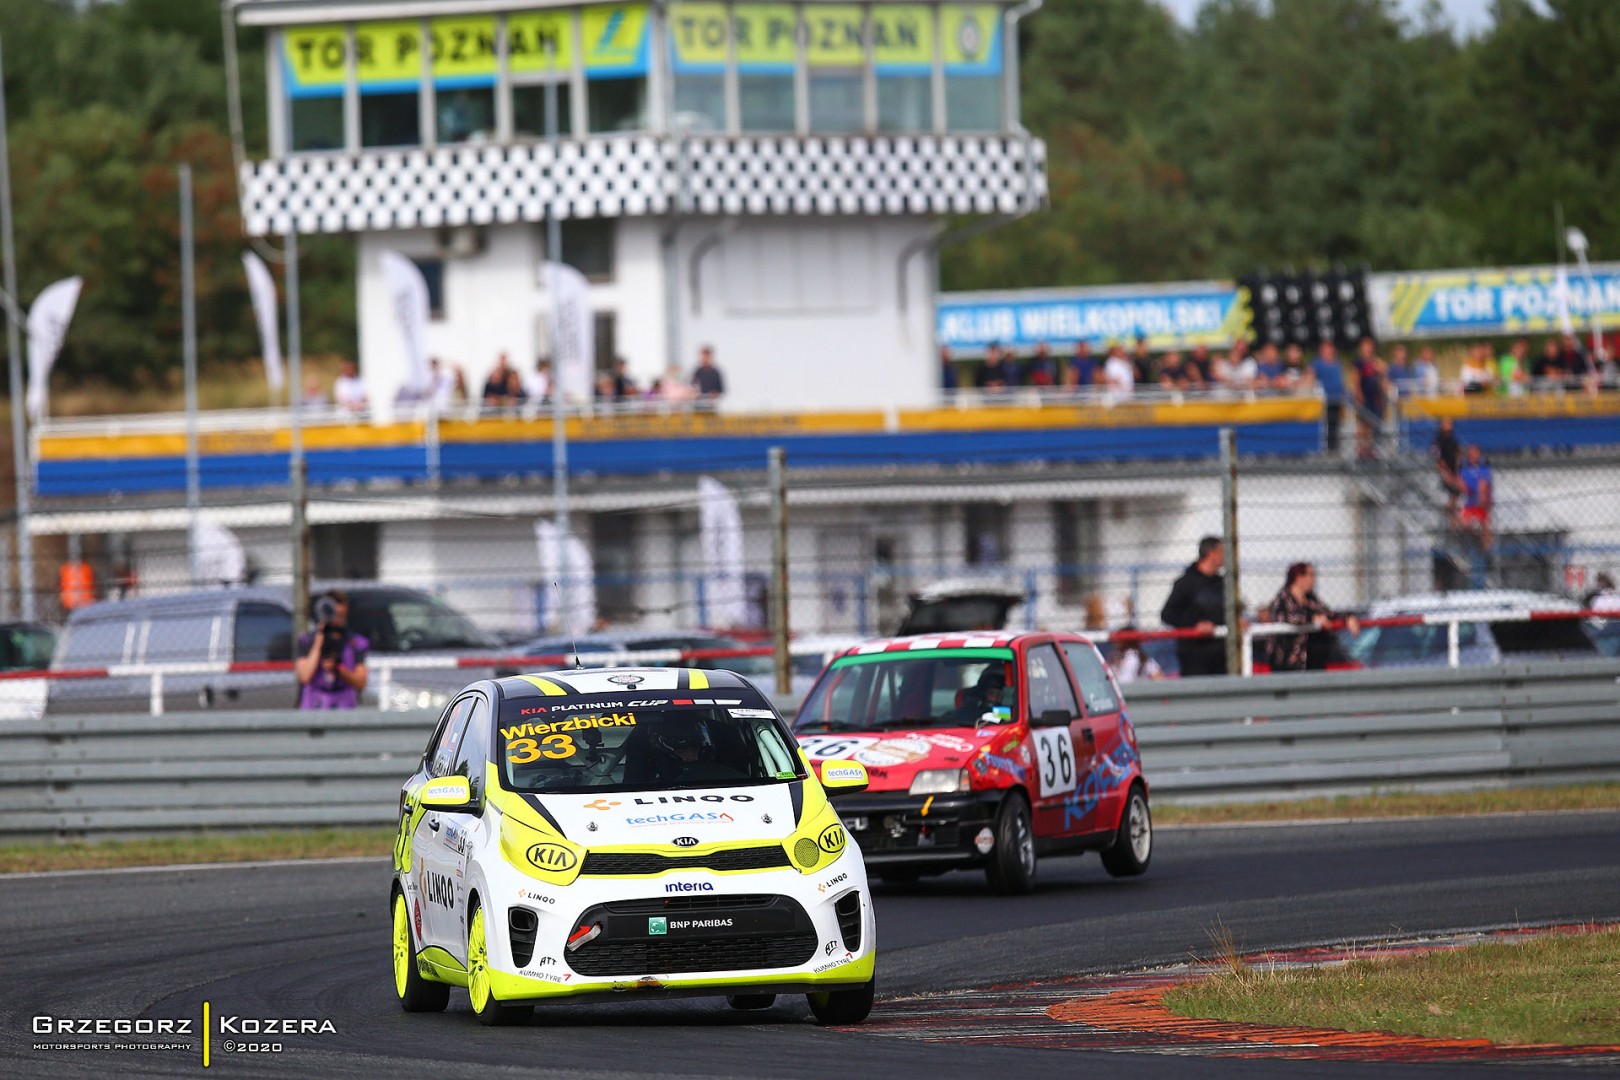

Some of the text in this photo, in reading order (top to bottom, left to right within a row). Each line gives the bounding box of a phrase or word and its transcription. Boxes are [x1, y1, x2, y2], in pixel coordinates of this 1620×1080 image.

[681, 18, 751, 49] TOR
[296, 35, 376, 70] TOR
[1433, 289, 1496, 322] TOR
[521, 699, 669, 715] KIA PLATINUM CUP
[499, 712, 638, 741] Wierzbicki
[506, 733, 577, 765] 33
[1041, 733, 1072, 788] 36
[634, 794, 755, 806] LINQO
[675, 837, 698, 847] KIA
[823, 827, 843, 849] KIA
[533, 848, 567, 867] KIA
[665, 881, 714, 893] interia
[826, 872, 848, 888] LINQO
[426, 870, 455, 911] LINQO
[527, 891, 556, 905] LINQO
[669, 918, 733, 930] BNP PARIBAS
[518, 969, 562, 983] KUMHO TYRE
